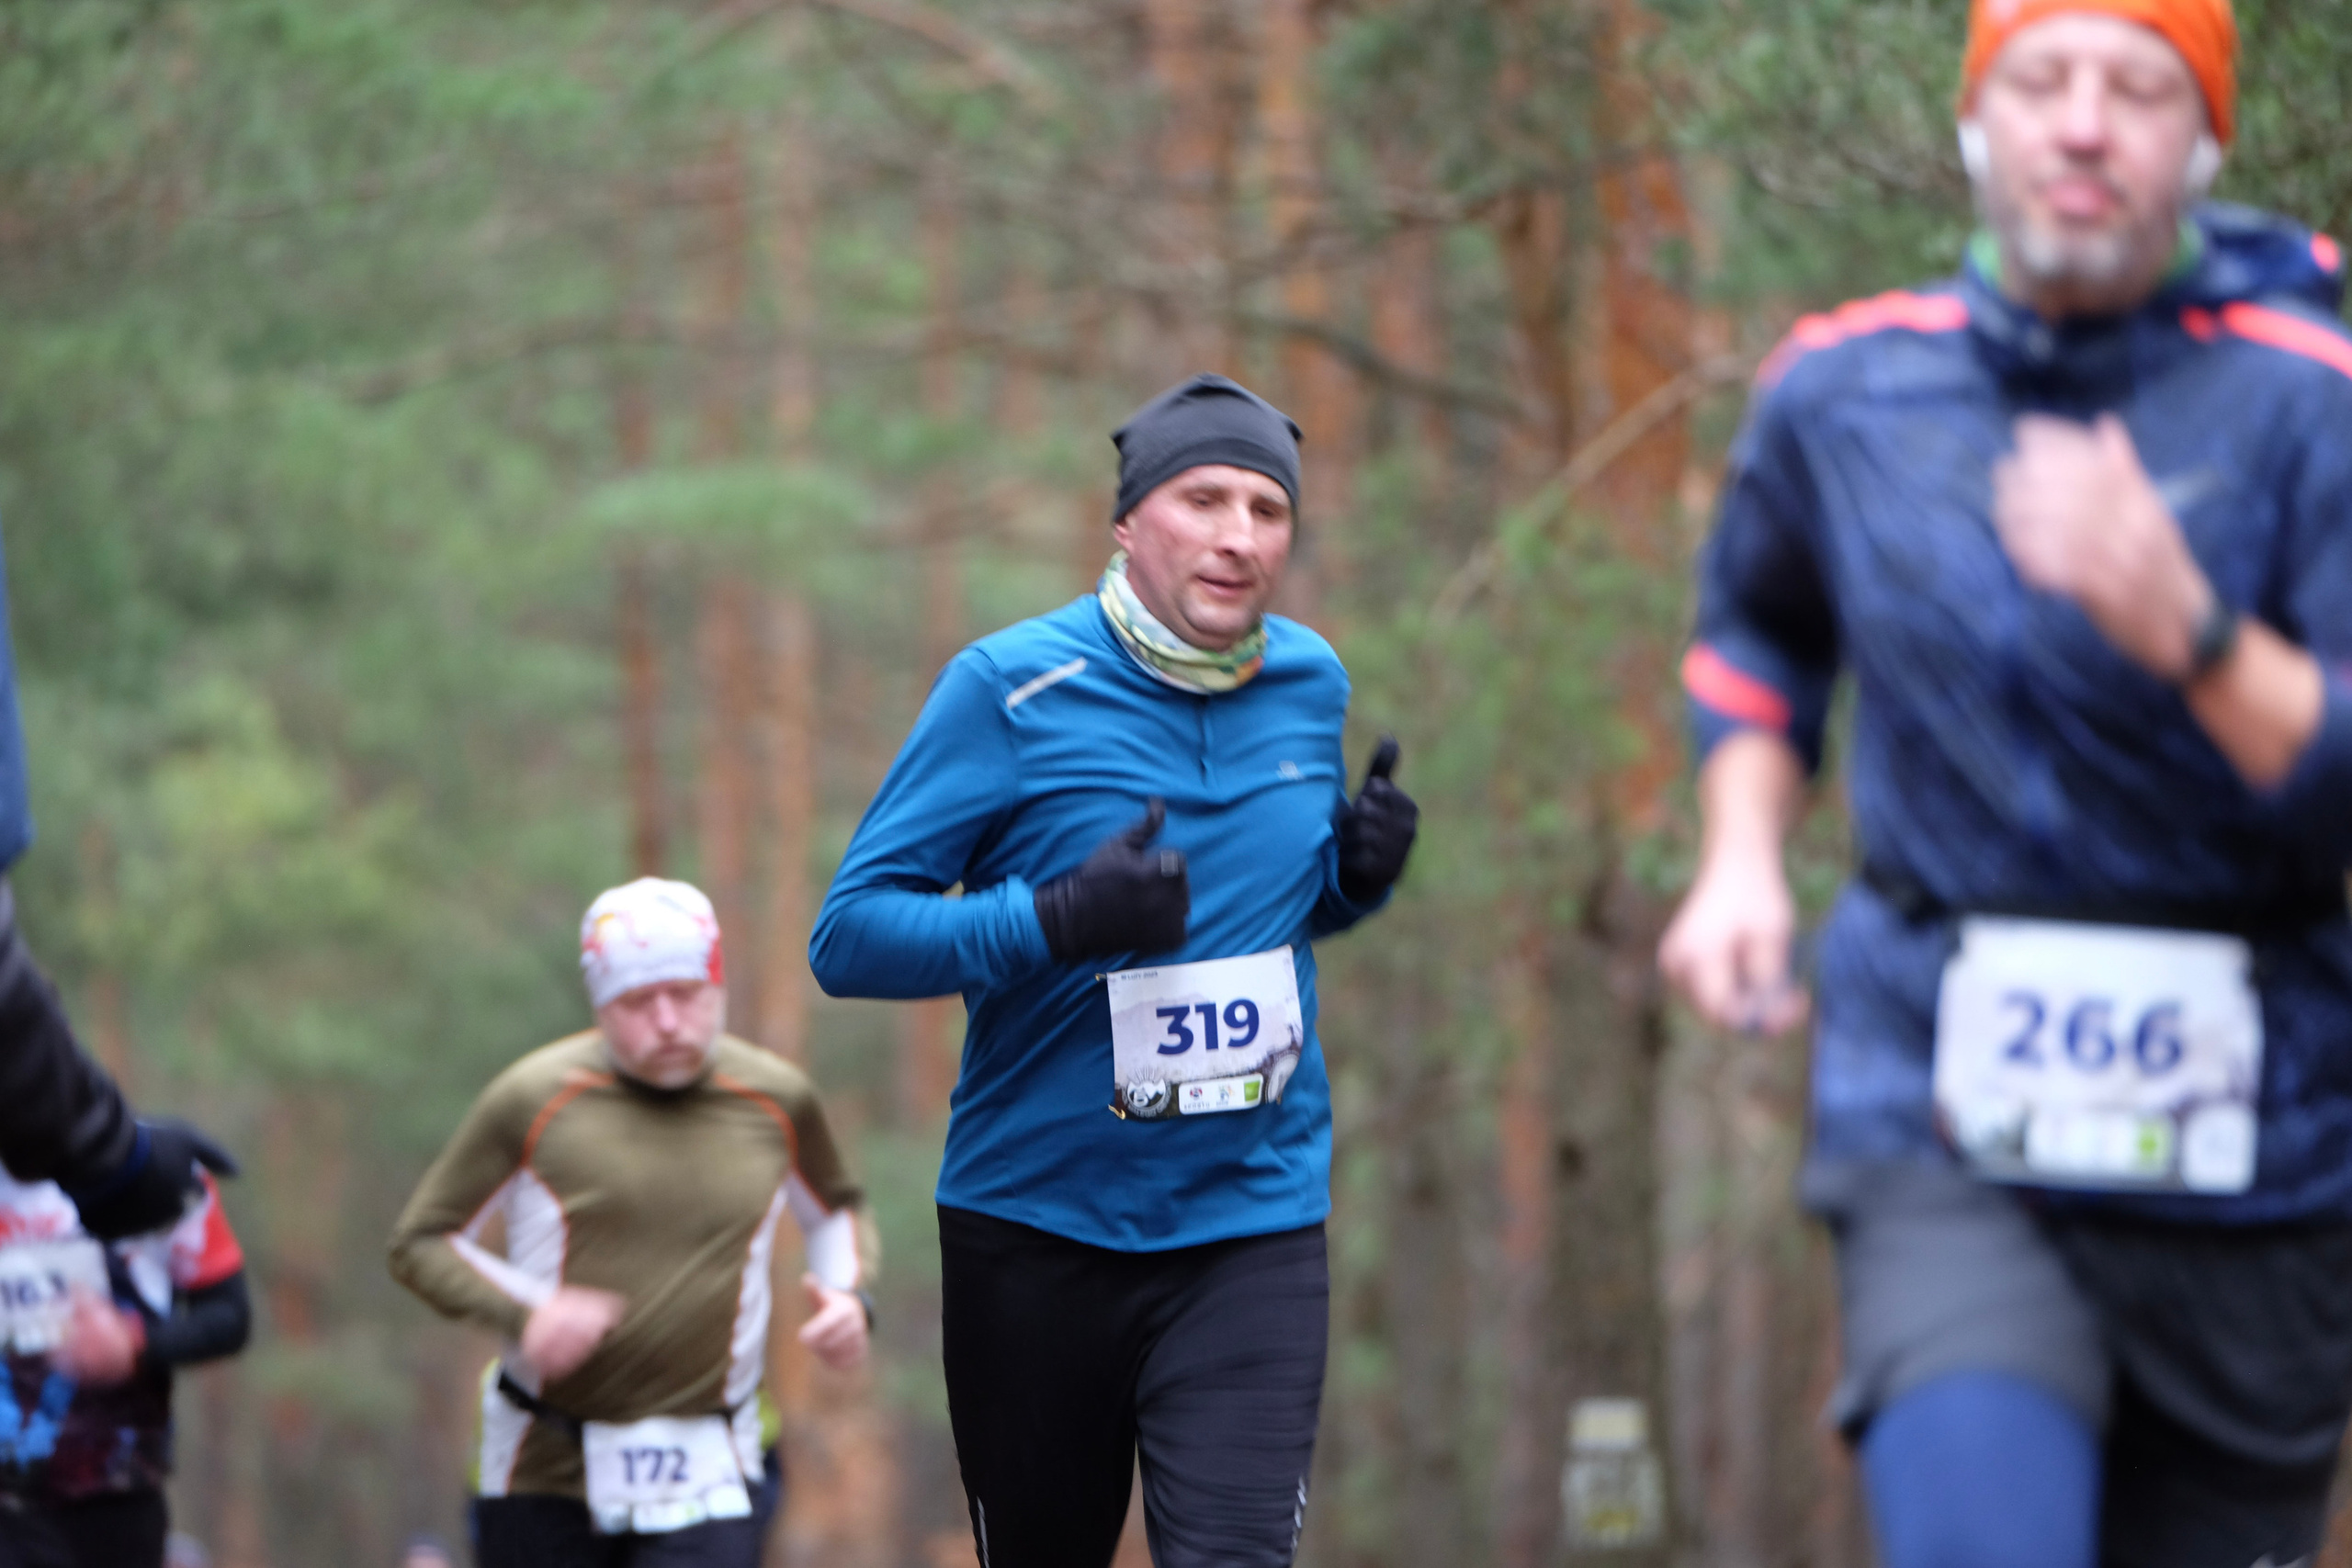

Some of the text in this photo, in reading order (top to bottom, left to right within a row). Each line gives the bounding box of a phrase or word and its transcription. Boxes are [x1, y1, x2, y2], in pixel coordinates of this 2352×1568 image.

[1156, 998, 1260, 1055] 319
[1996, 987, 2186, 1077] 266
[620, 1447, 688, 1485] 172
